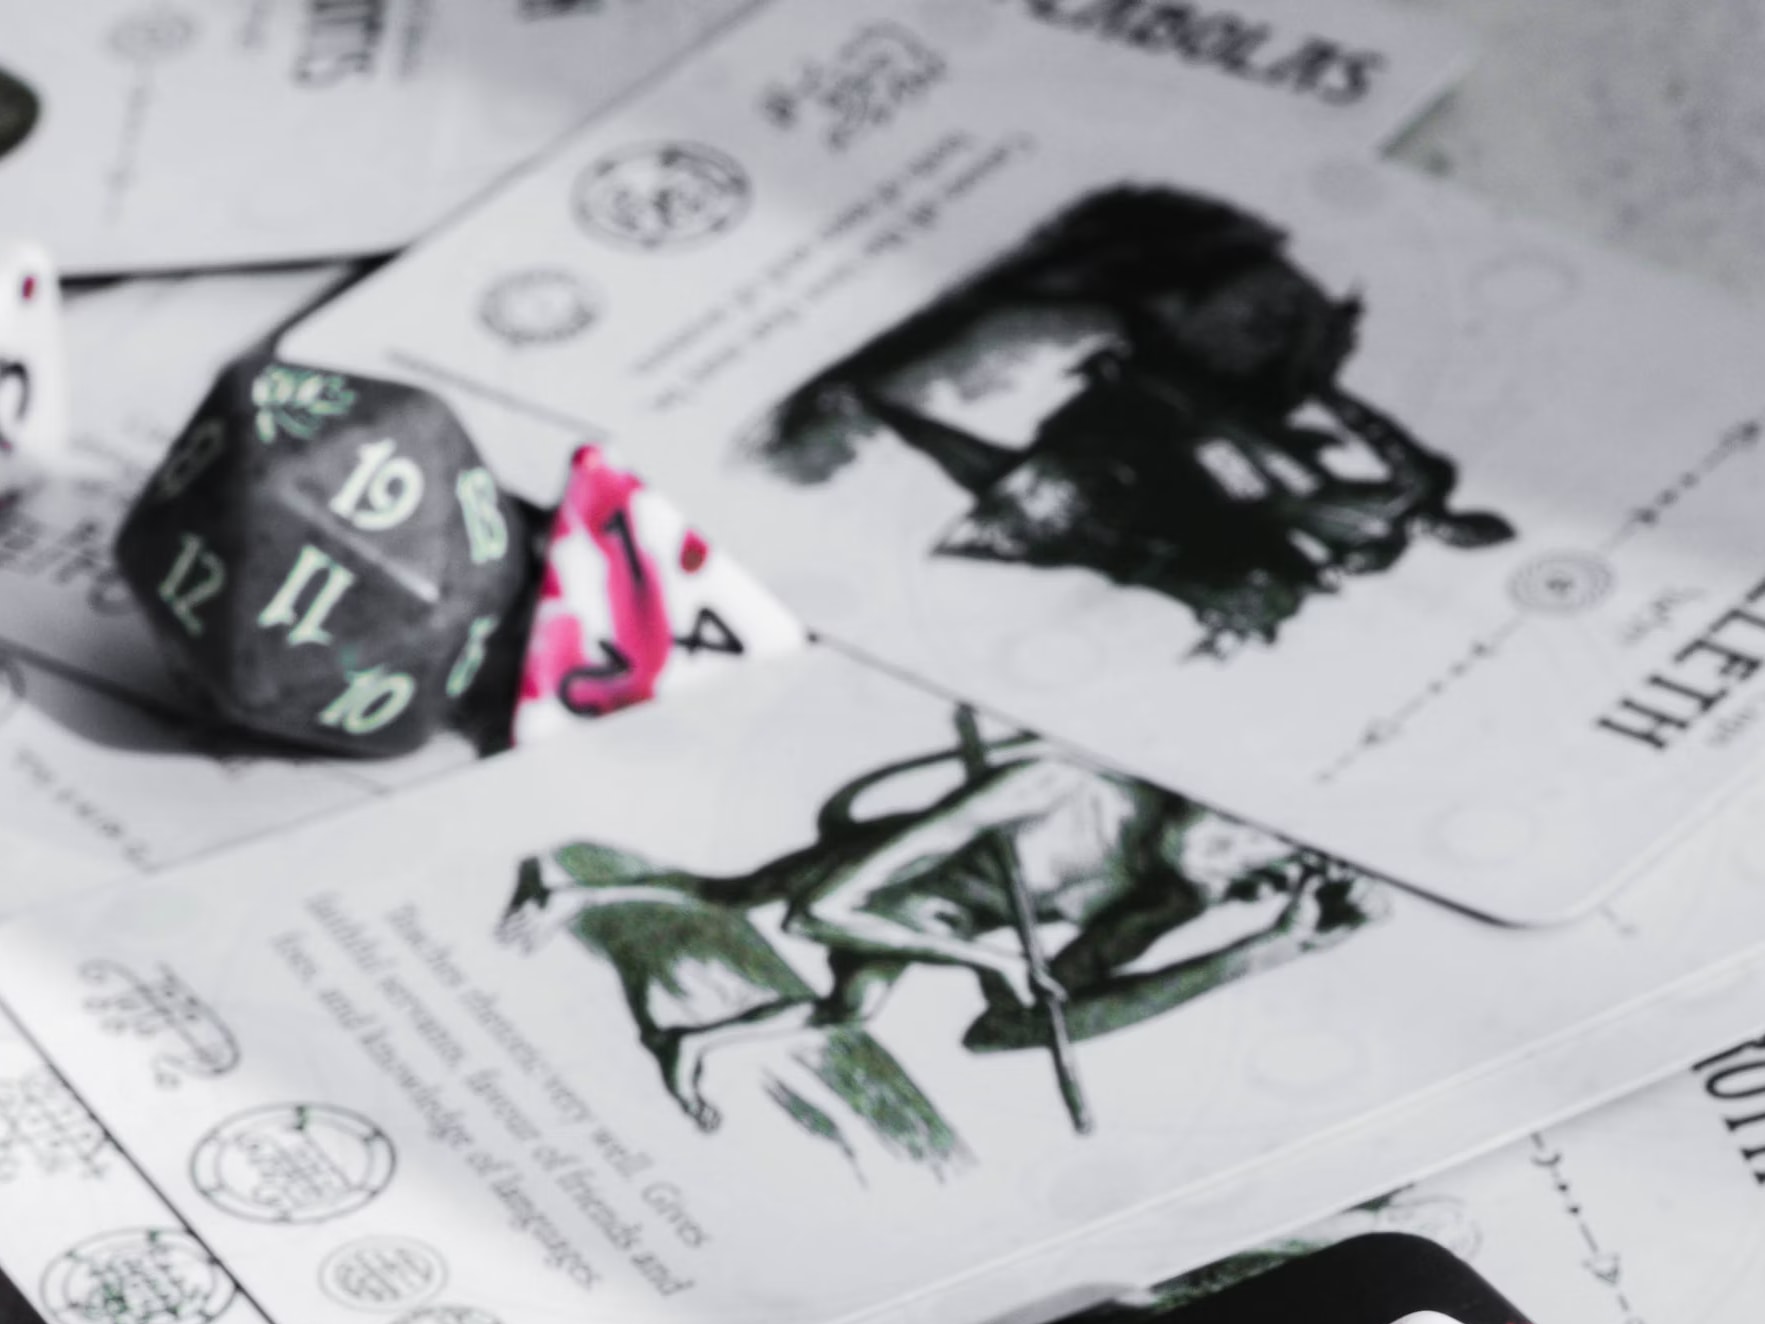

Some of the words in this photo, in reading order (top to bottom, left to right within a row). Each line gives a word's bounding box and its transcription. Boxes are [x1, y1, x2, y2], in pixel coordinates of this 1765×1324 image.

[329, 439, 424, 530] 19
[671, 606, 744, 655] 4
[319, 666, 415, 735] 10
[316, 985, 377, 1028] and
[357, 1026, 474, 1149] knowledge
[463, 1152, 515, 1173] of
[530, 1146, 583, 1169] of
[541, 1074, 595, 1123] very
[639, 1179, 712, 1247] Gives
[555, 1167, 641, 1249] friends
[626, 1250, 696, 1297] and
